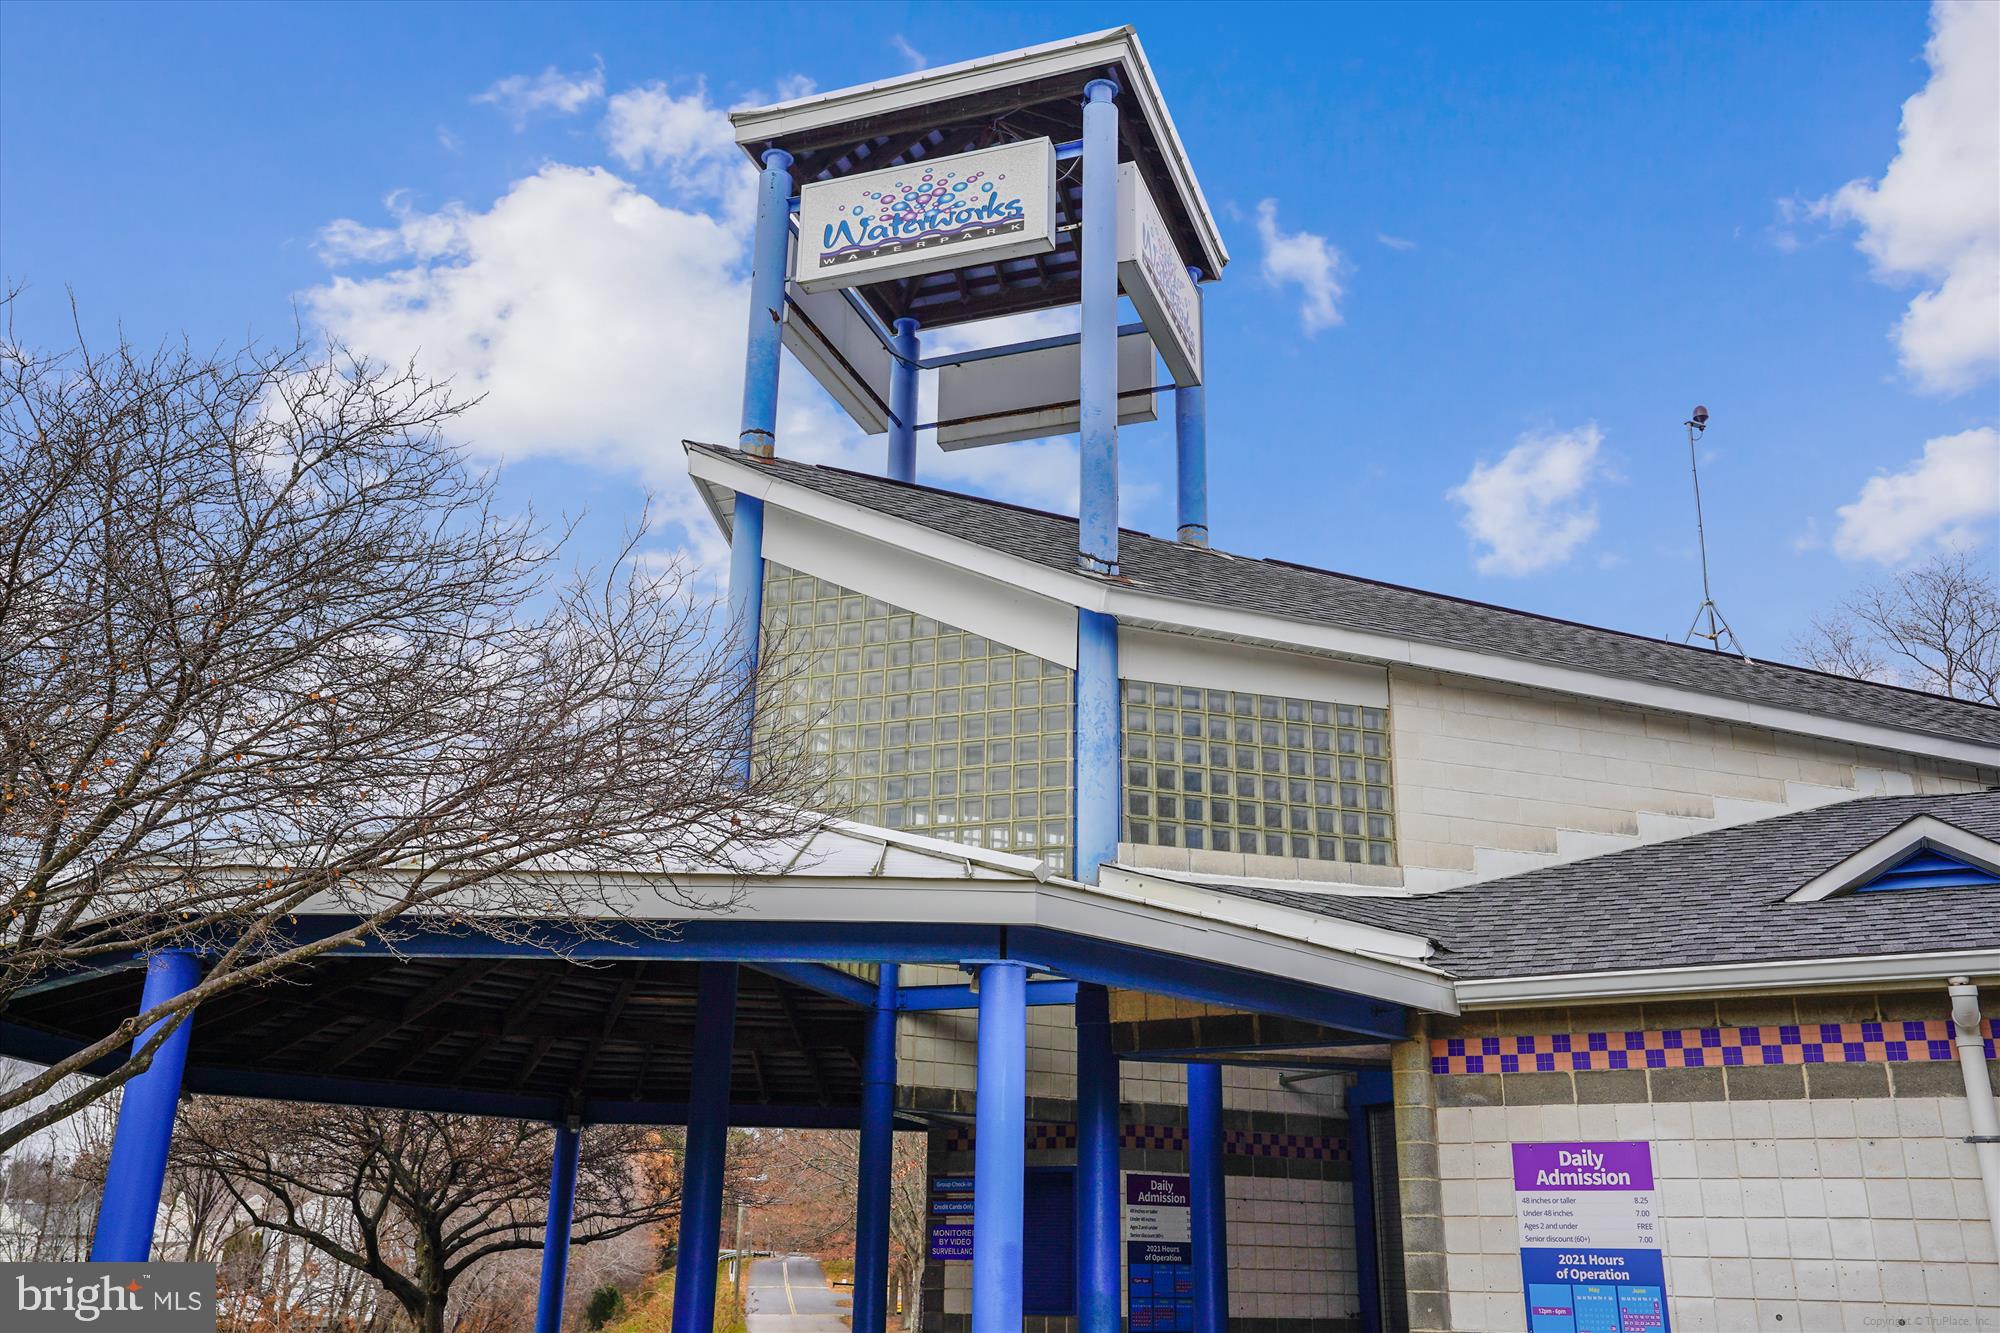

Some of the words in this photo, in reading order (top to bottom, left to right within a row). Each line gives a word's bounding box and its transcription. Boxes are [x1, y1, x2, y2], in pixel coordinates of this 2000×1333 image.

[823, 191, 1023, 249] Waterworks
[823, 223, 1021, 265] WATERPARK
[1558, 1150, 1603, 1170] Daily
[1536, 1169, 1631, 1186] Admission
[1151, 1180, 1173, 1193] Daily
[1138, 1192, 1186, 1203] Admission
[1152, 1254, 1182, 1263] Operation
[1558, 1255, 1586, 1265] 2021
[1589, 1255, 1624, 1265] Hours
[1556, 1269, 1568, 1279] of
[1570, 1269, 1630, 1281] Operation
